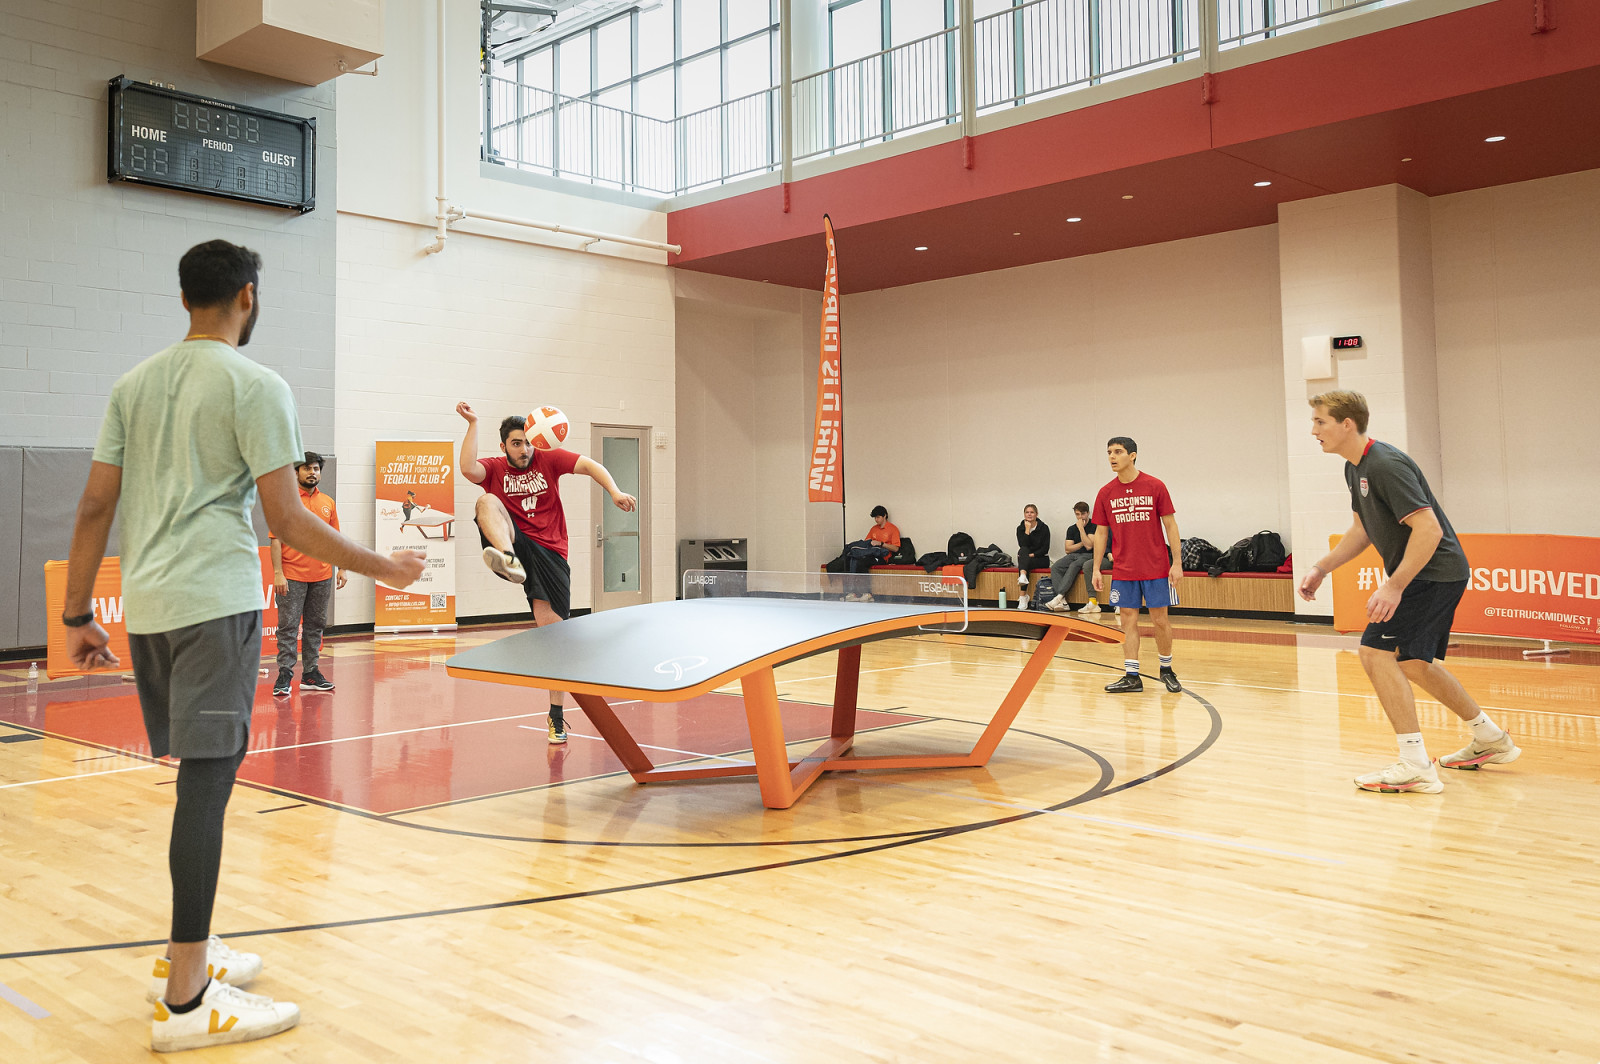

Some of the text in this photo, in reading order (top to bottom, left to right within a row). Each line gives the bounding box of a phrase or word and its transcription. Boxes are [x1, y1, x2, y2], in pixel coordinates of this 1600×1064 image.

[131, 124, 167, 143] HOME
[202, 138, 234, 153] PERIOD
[262, 150, 297, 167] GUEST
[416, 455, 445, 465] READY
[387, 462, 415, 473] START
[384, 474, 417, 485] TEQBALL
[503, 472, 549, 494] CHAMPIONS
[1110, 495, 1154, 509] WISCONSIN
[1115, 512, 1151, 524] BADGERS
[918, 581, 959, 595] TEQBALL
[1484, 606, 1593, 626] @TEQTRUCKMIDWEST
